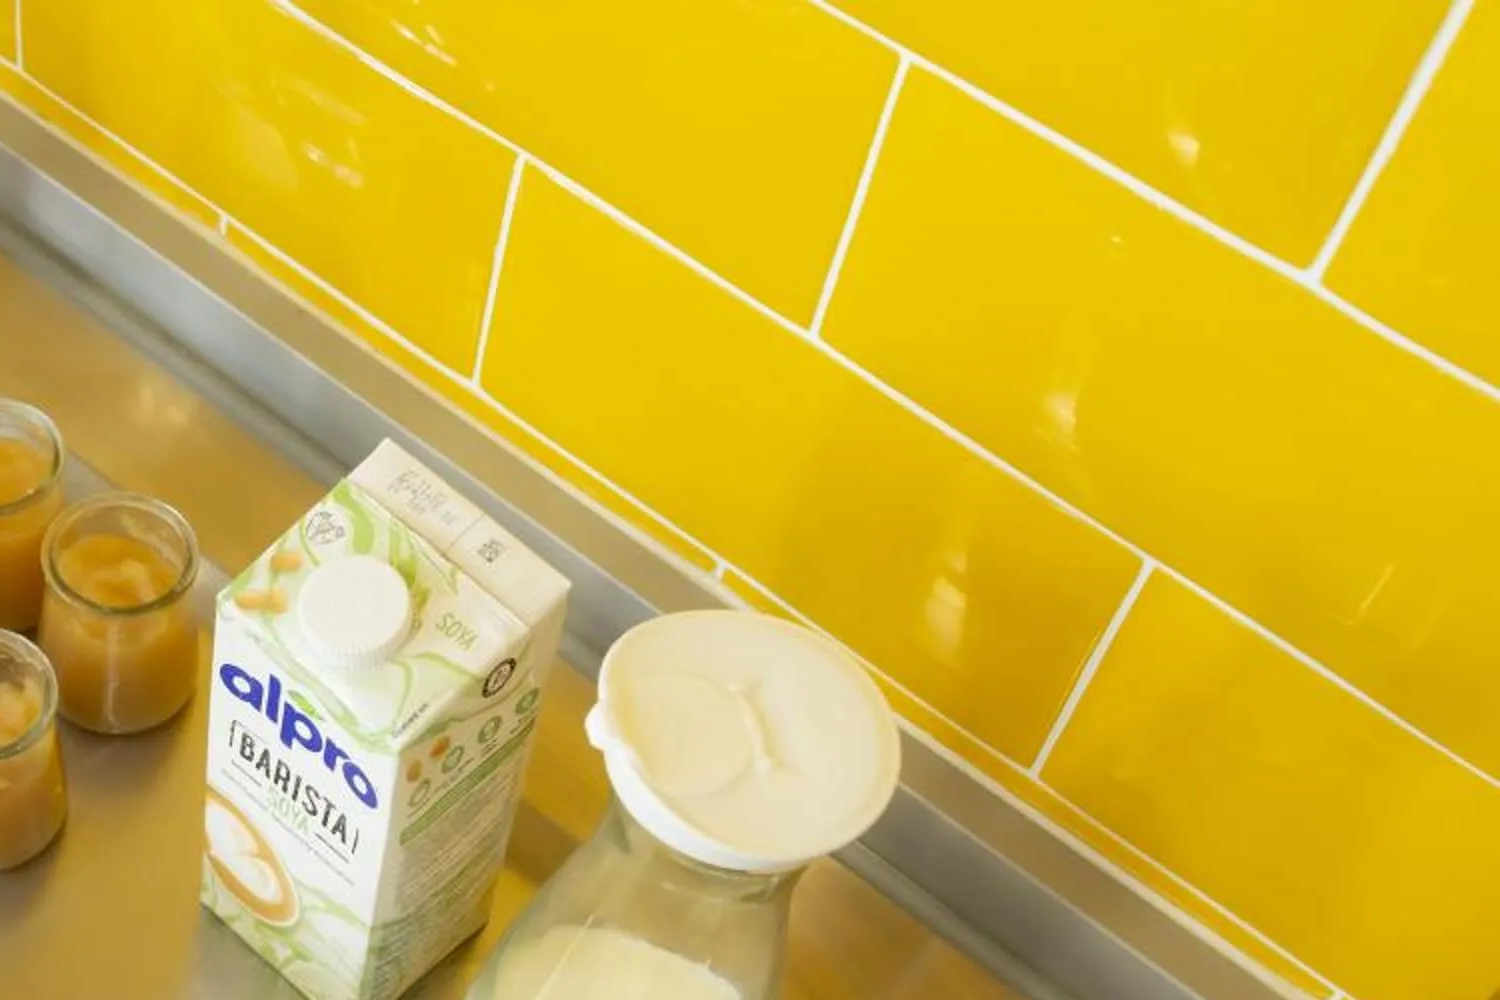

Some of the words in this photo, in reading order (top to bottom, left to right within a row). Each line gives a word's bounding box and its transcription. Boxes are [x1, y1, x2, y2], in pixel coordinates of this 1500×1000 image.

[436, 612, 480, 651] SOYA
[219, 663, 378, 810] alpro
[239, 732, 348, 845] BARISTA
